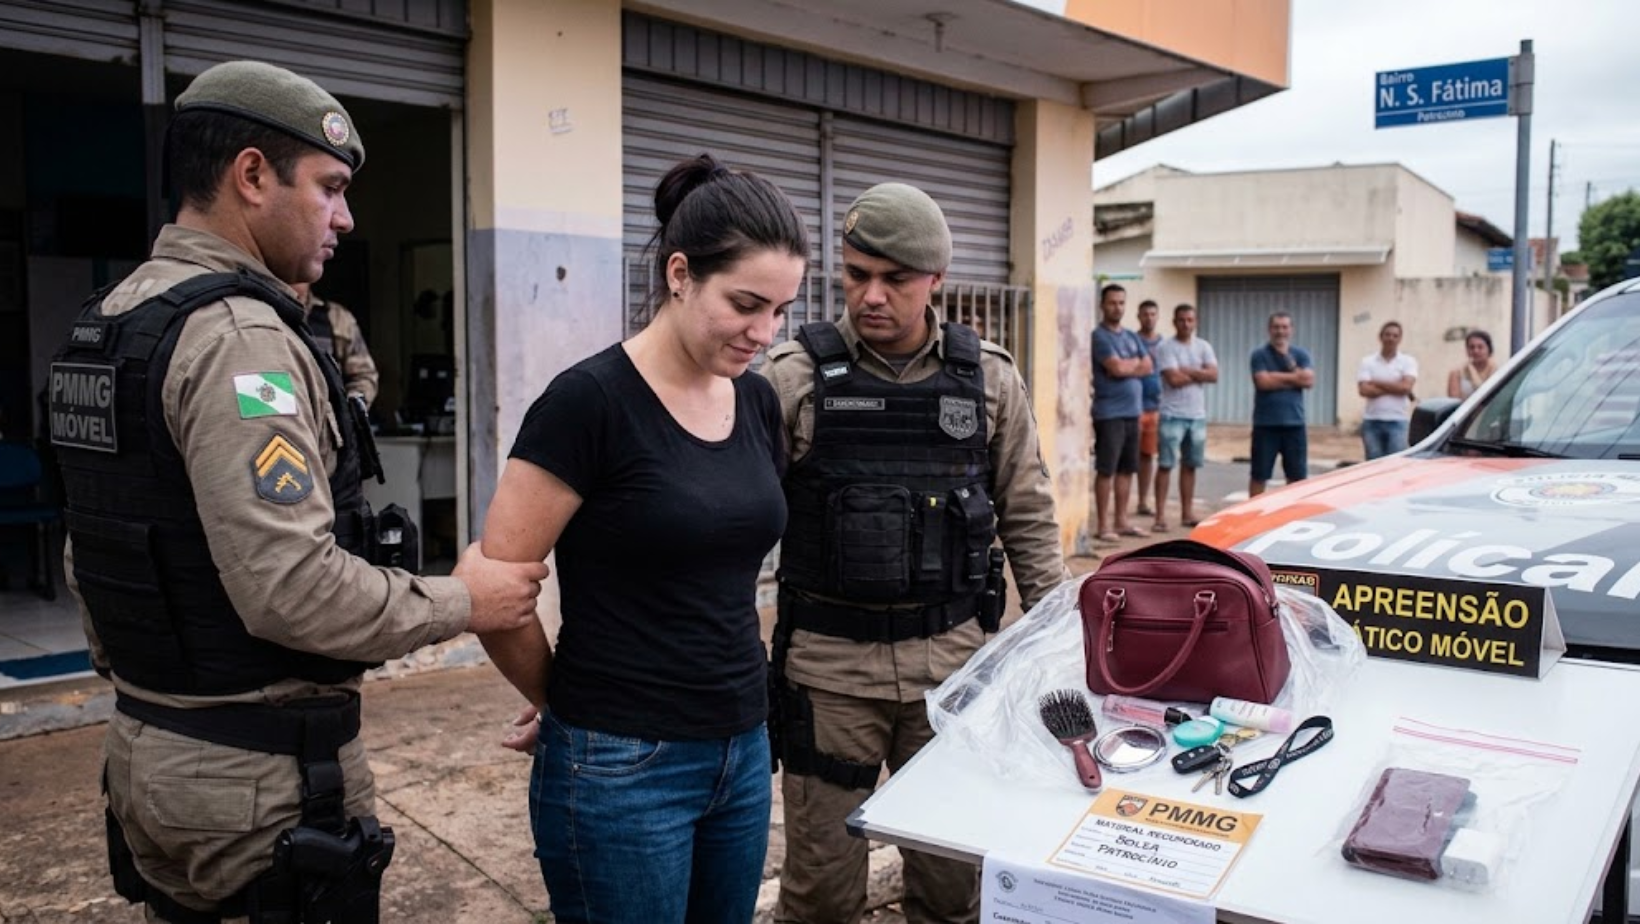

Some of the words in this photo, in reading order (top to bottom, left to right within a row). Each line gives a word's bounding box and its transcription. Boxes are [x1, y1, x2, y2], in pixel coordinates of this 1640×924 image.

[1380, 87, 1401, 108] N.
[1406, 83, 1425, 106] S.
[1431, 77, 1503, 103] Fátima
[71, 326, 102, 343] PMMG
[52, 372, 112, 407] PMMG
[53, 407, 114, 444] MÓVEL
[1332, 583, 1530, 629] APREENSÃO
[1350, 618, 1423, 654] ÁTICO
[1430, 631, 1525, 667] MÓVEL
[1149, 802, 1238, 832] PMMG
[1097, 844, 1178, 869] PATROCÍNIO
